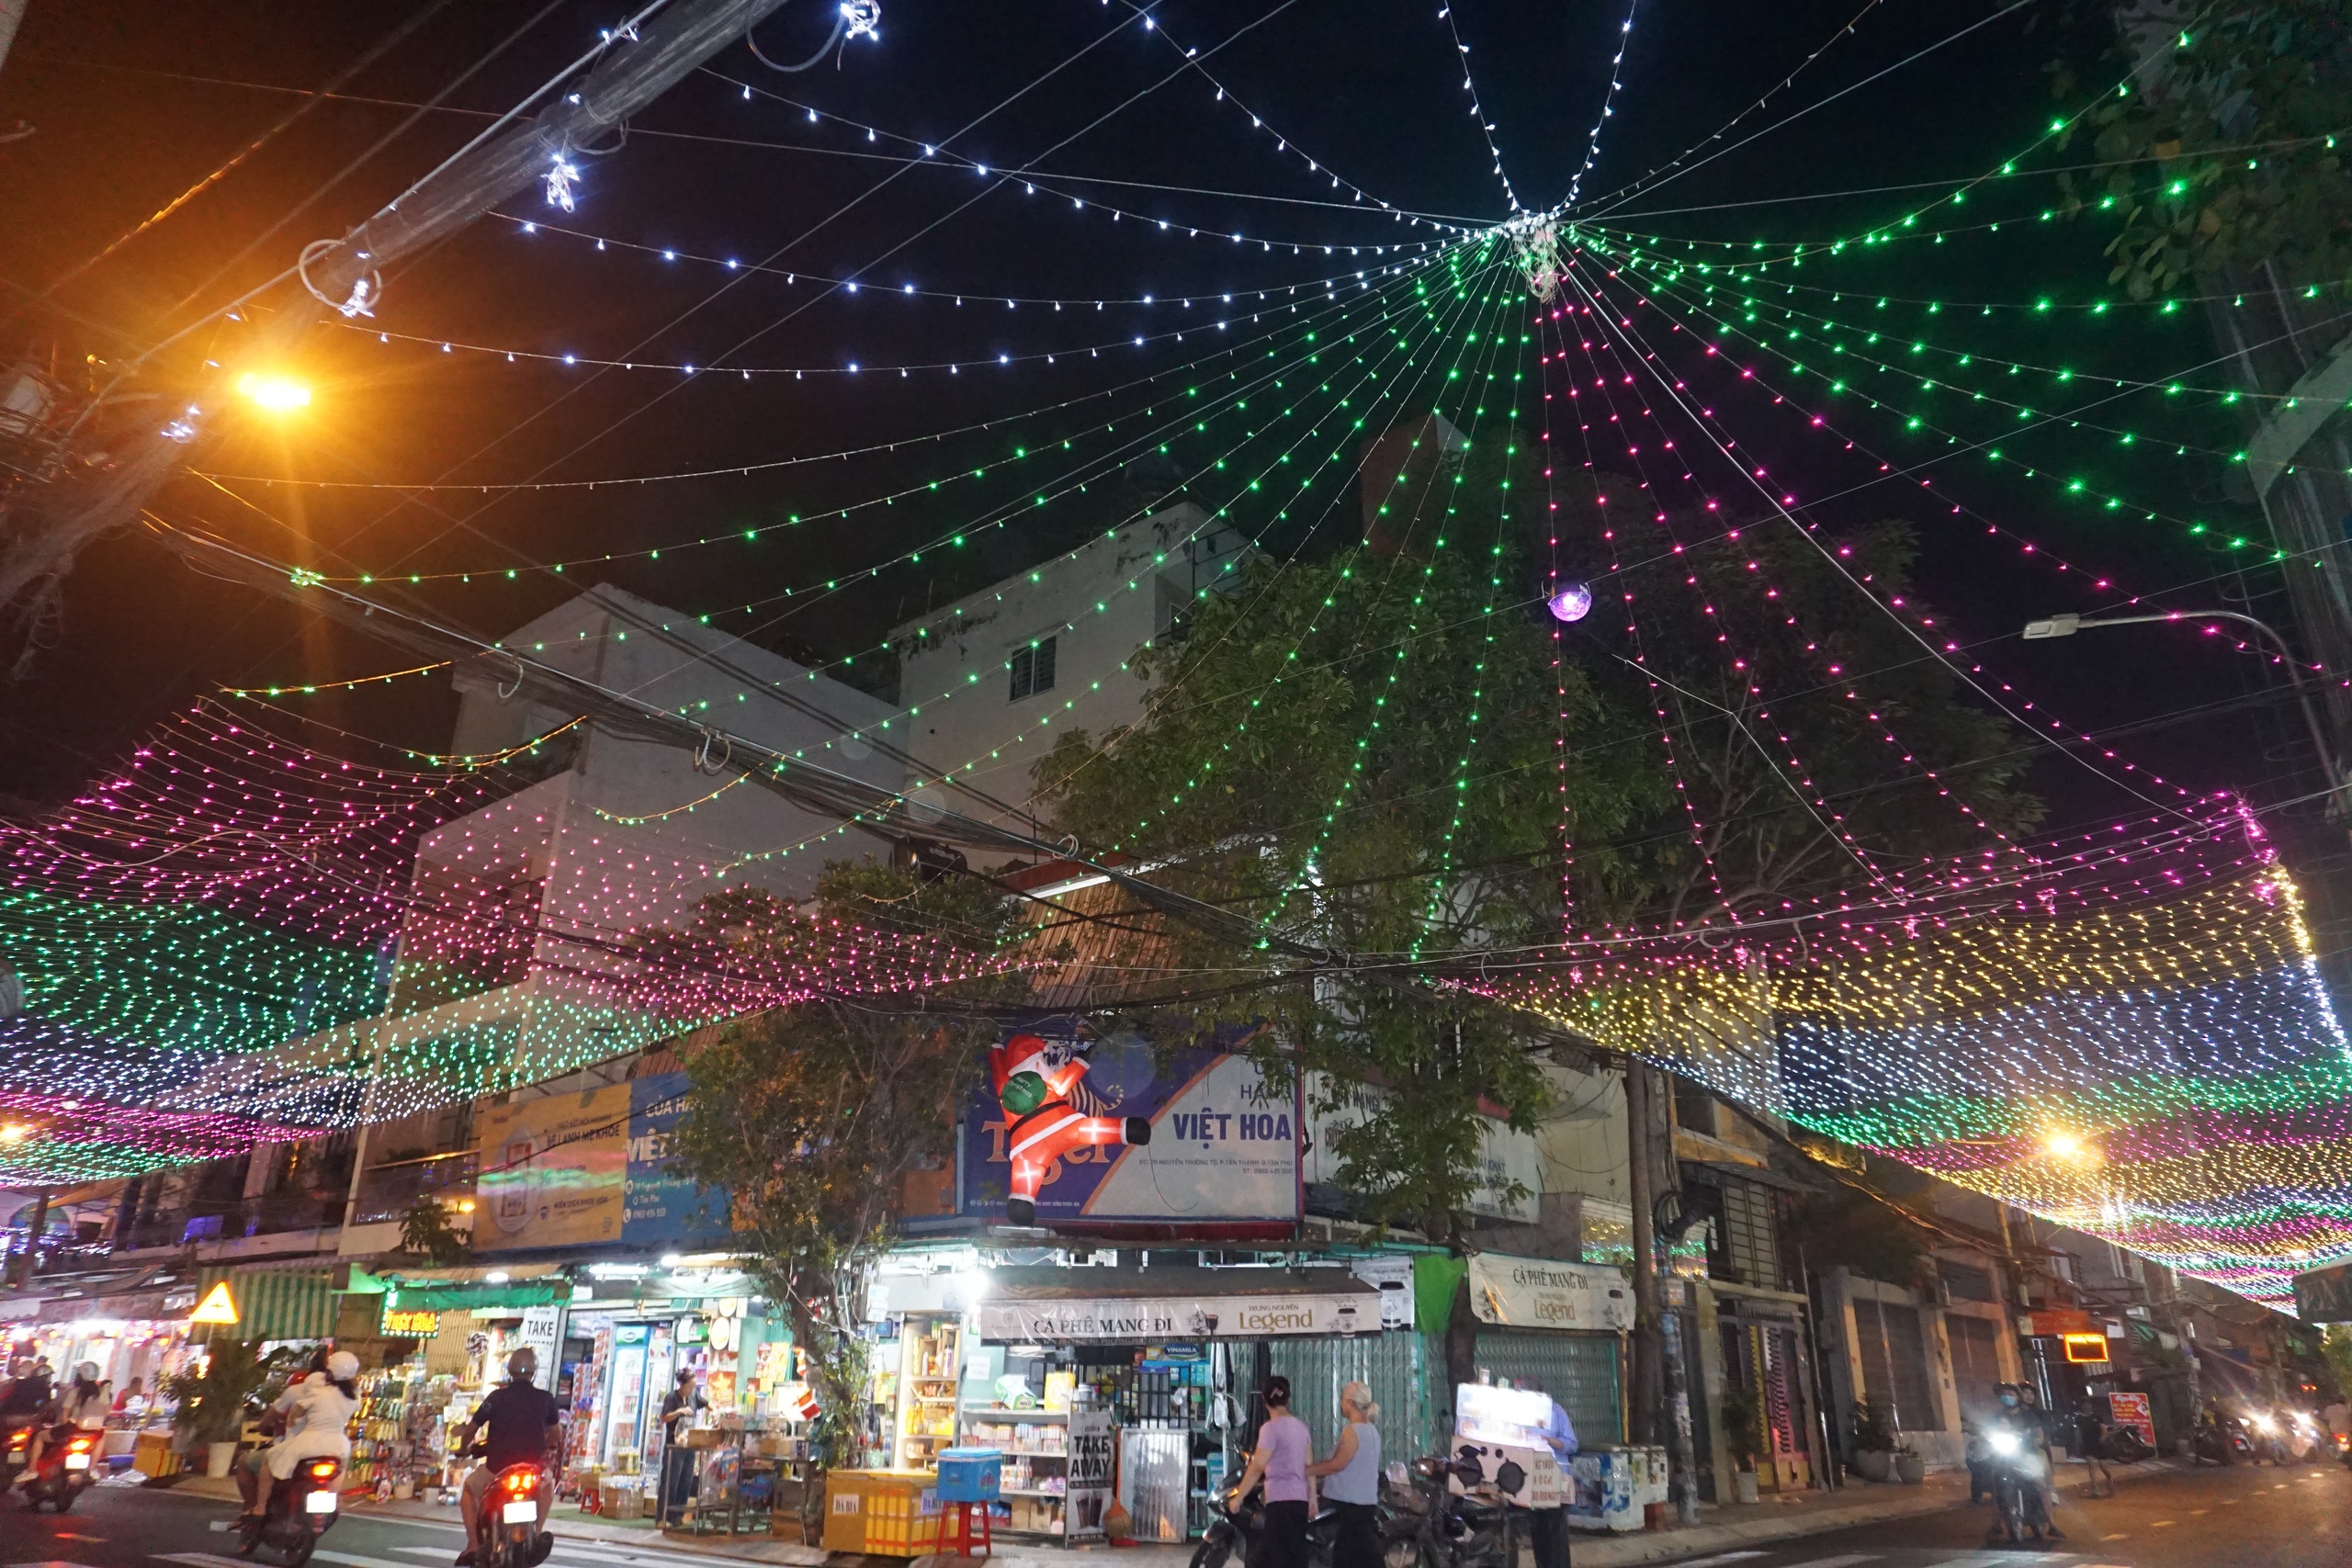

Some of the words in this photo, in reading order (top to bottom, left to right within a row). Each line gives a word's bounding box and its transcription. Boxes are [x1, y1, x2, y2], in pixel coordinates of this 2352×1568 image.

[1172, 1107, 1232, 1149] VIỆT
[1240, 1113, 1292, 1141] HOA
[1513, 1266, 1526, 1284] CÀ
[1528, 1268, 1547, 1287] PHÊ
[1549, 1272, 1577, 1289] MANG
[1577, 1276, 1589, 1290] ĐI
[1239, 1309, 1313, 1333] Legend
[1534, 1299, 1577, 1324] Legend
[527, 1320, 553, 1337] TAKE
[1034, 1317, 1055, 1334] CÀ
[1060, 1316, 1093, 1333] PHÊ
[1099, 1318, 1149, 1333] MANG
[1154, 1318, 1172, 1332] ĐI
[1073, 1435, 1111, 1454] TAKE
[1070, 1459, 1111, 1477] AWAY
